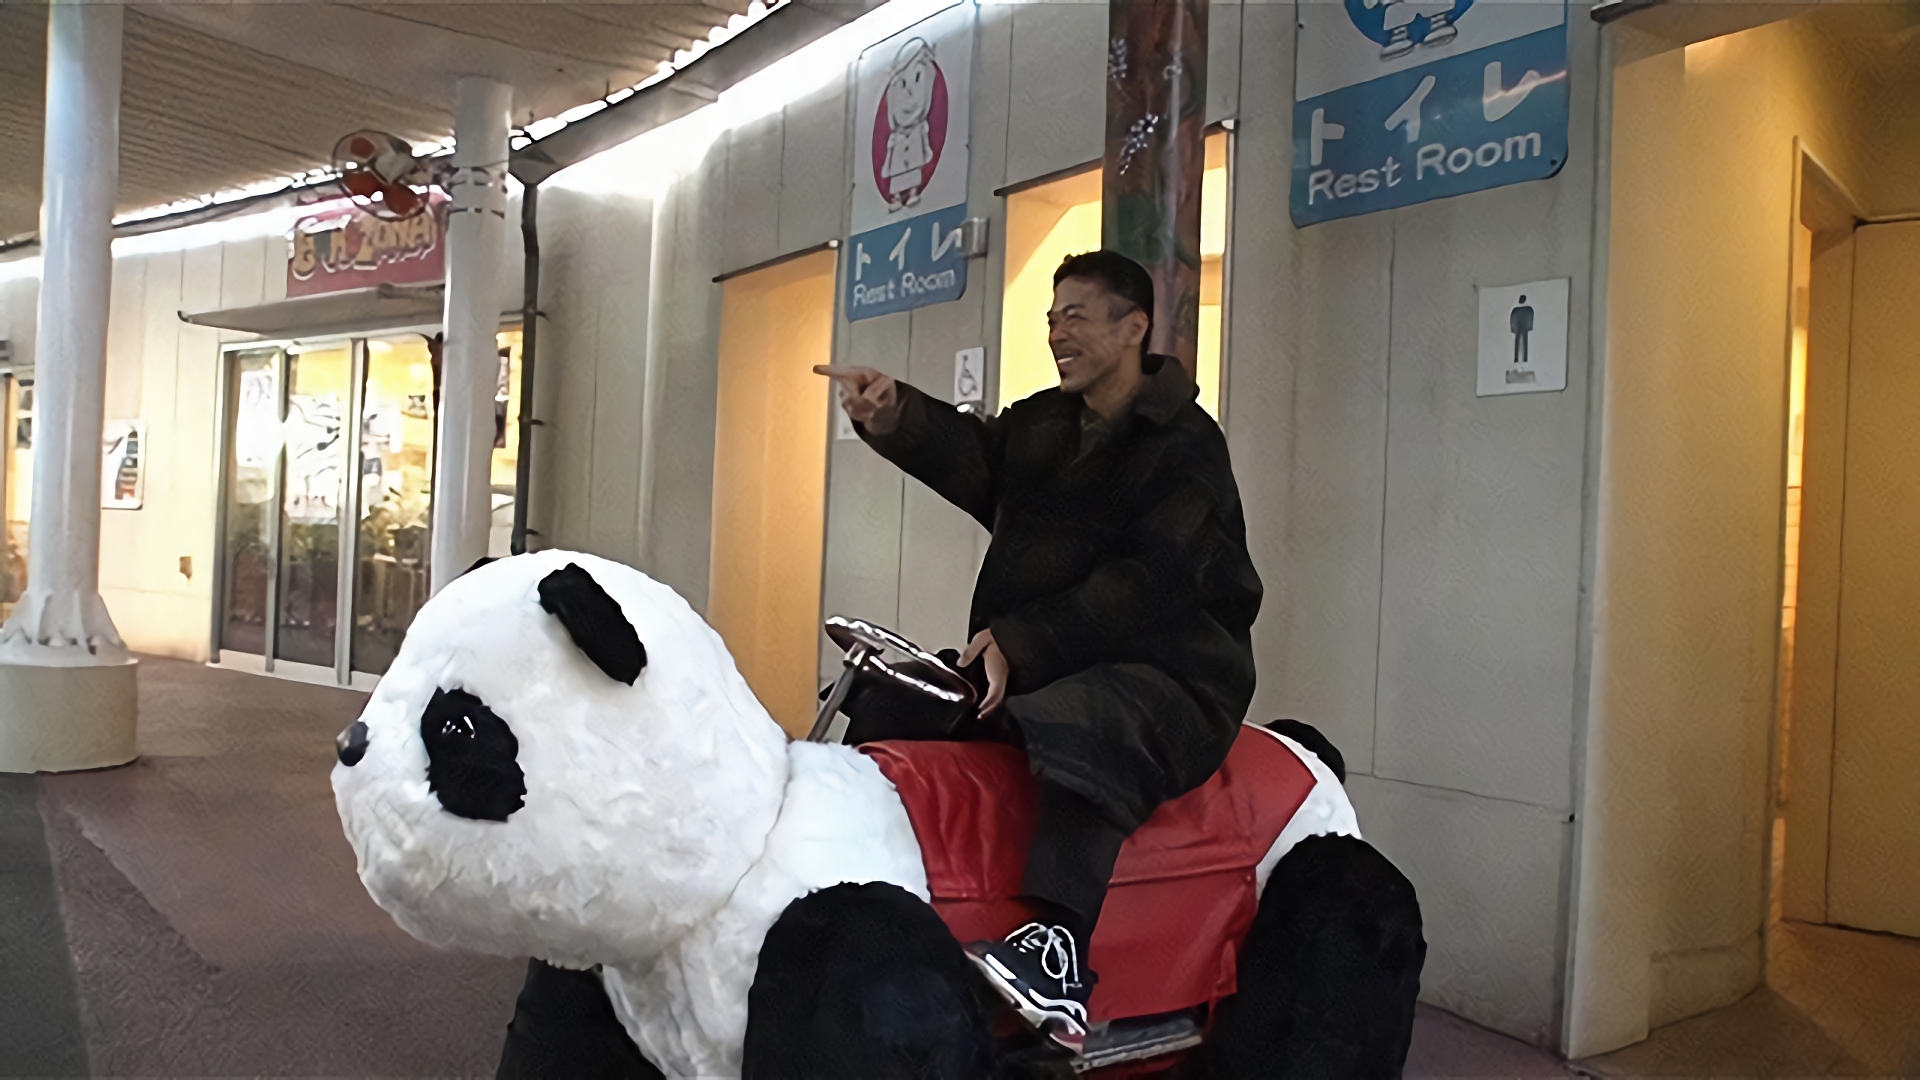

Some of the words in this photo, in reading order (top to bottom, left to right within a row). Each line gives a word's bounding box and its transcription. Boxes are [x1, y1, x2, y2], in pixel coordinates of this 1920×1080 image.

[1309, 61, 1541, 167] トイレ
[1307, 155, 1402, 206] Rest
[1416, 131, 1542, 181] Room
[855, 221, 962, 281] トイレ
[853, 279, 895, 308] Rest
[901, 269, 956, 298] Room
